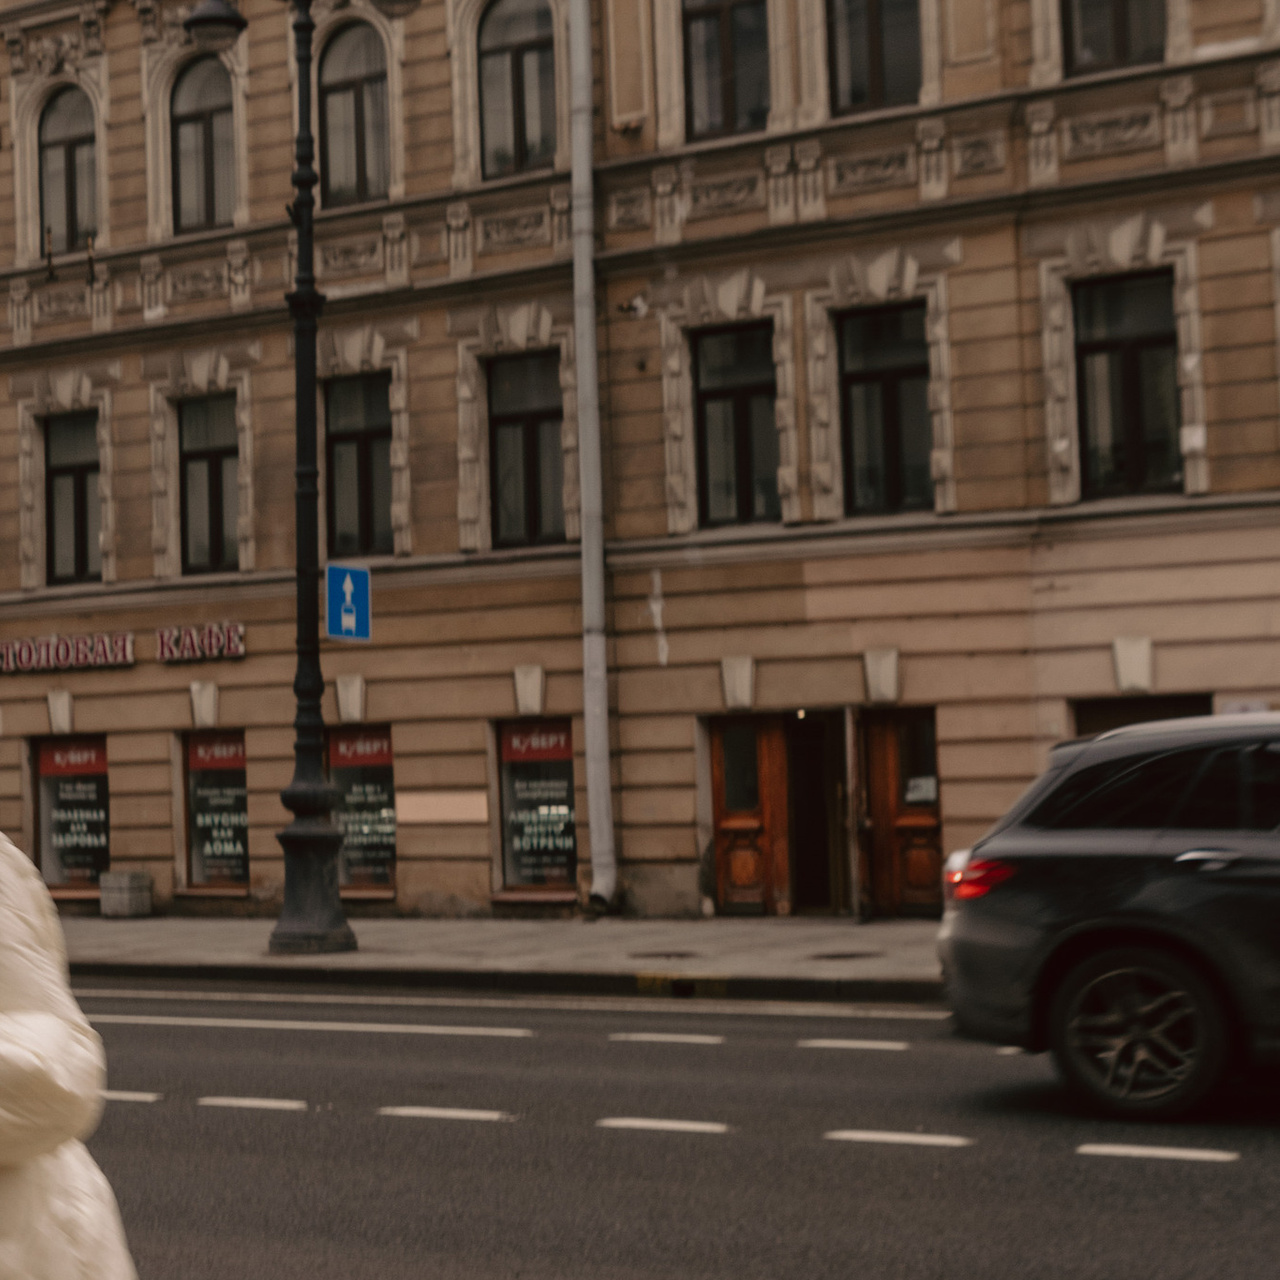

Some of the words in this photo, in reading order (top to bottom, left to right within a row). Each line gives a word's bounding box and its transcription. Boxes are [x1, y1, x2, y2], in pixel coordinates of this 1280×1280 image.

[157, 621, 246, 661] КАФЕ
[196, 812, 248, 827] ВКУСНО
[203, 840, 244, 856] ДОМА
